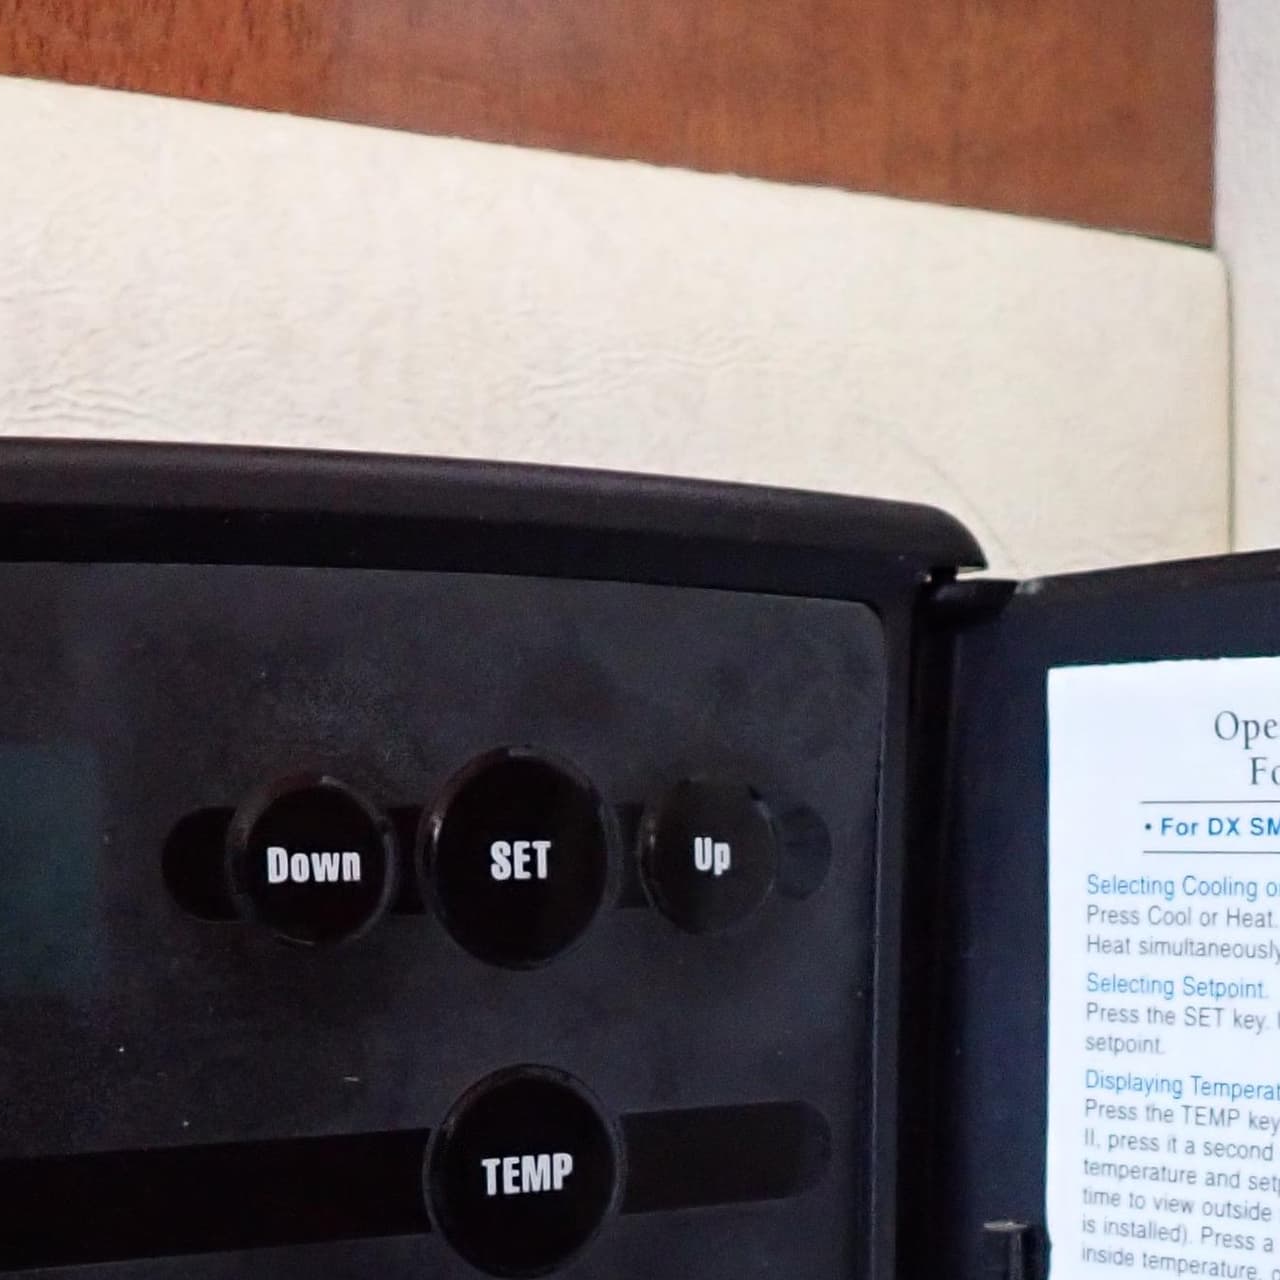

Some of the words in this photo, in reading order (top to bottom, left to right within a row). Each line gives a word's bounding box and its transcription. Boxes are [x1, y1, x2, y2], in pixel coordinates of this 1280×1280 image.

[1160, 817, 1200, 836] For
[1207, 817, 1241, 836] DX
[266, 846, 361, 884] Down
[490, 840, 552, 881] SET
[694, 836, 731, 877] Up
[1086, 873, 1177, 902] Selecting
[1181, 874, 1259, 903] Cooling
[1086, 904, 1141, 925] Press
[1147, 905, 1192, 926] Cool
[1198, 911, 1219, 927] or
[1225, 908, 1279, 928] Heat.
[1085, 934, 1132, 955] Heat
[1085, 972, 1177, 1001] Selecting
[1181, 975, 1269, 1002] Setpoint.
[1085, 1002, 1140, 1024] Press
[1145, 1007, 1177, 1026] the
[1183, 1005, 1226, 1027] SET
[1232, 1009, 1270, 1035] key.
[1084, 1035, 1168, 1056] setpoint.
[1084, 1068, 1184, 1100] Displaying
[1084, 1098, 1138, 1121] Press
[1144, 1104, 1175, 1123] the
[1180, 1104, 1241, 1127] TEMP
[1107, 1133, 1161, 1152] press
[1166, 1136, 1178, 1153] it
[1183, 1140, 1196, 1155] a
[1202, 1141, 1275, 1162] second
[481, 1152, 573, 1196] TEMP
[1082, 1159, 1198, 1185] temperature
[1203, 1171, 1241, 1189] and
[1081, 1188, 1122, 1207] time
[1128, 1192, 1147, 1210] to
[1153, 1198, 1195, 1214] view
[1201, 1201, 1273, 1222] outside
[1081, 1219, 1097, 1234] is
[1103, 1221, 1191, 1245] installed).
[1200, 1226, 1256, 1251] Press
[1262, 1237, 1275, 1253] a
[1081, 1248, 1135, 1267] inside
